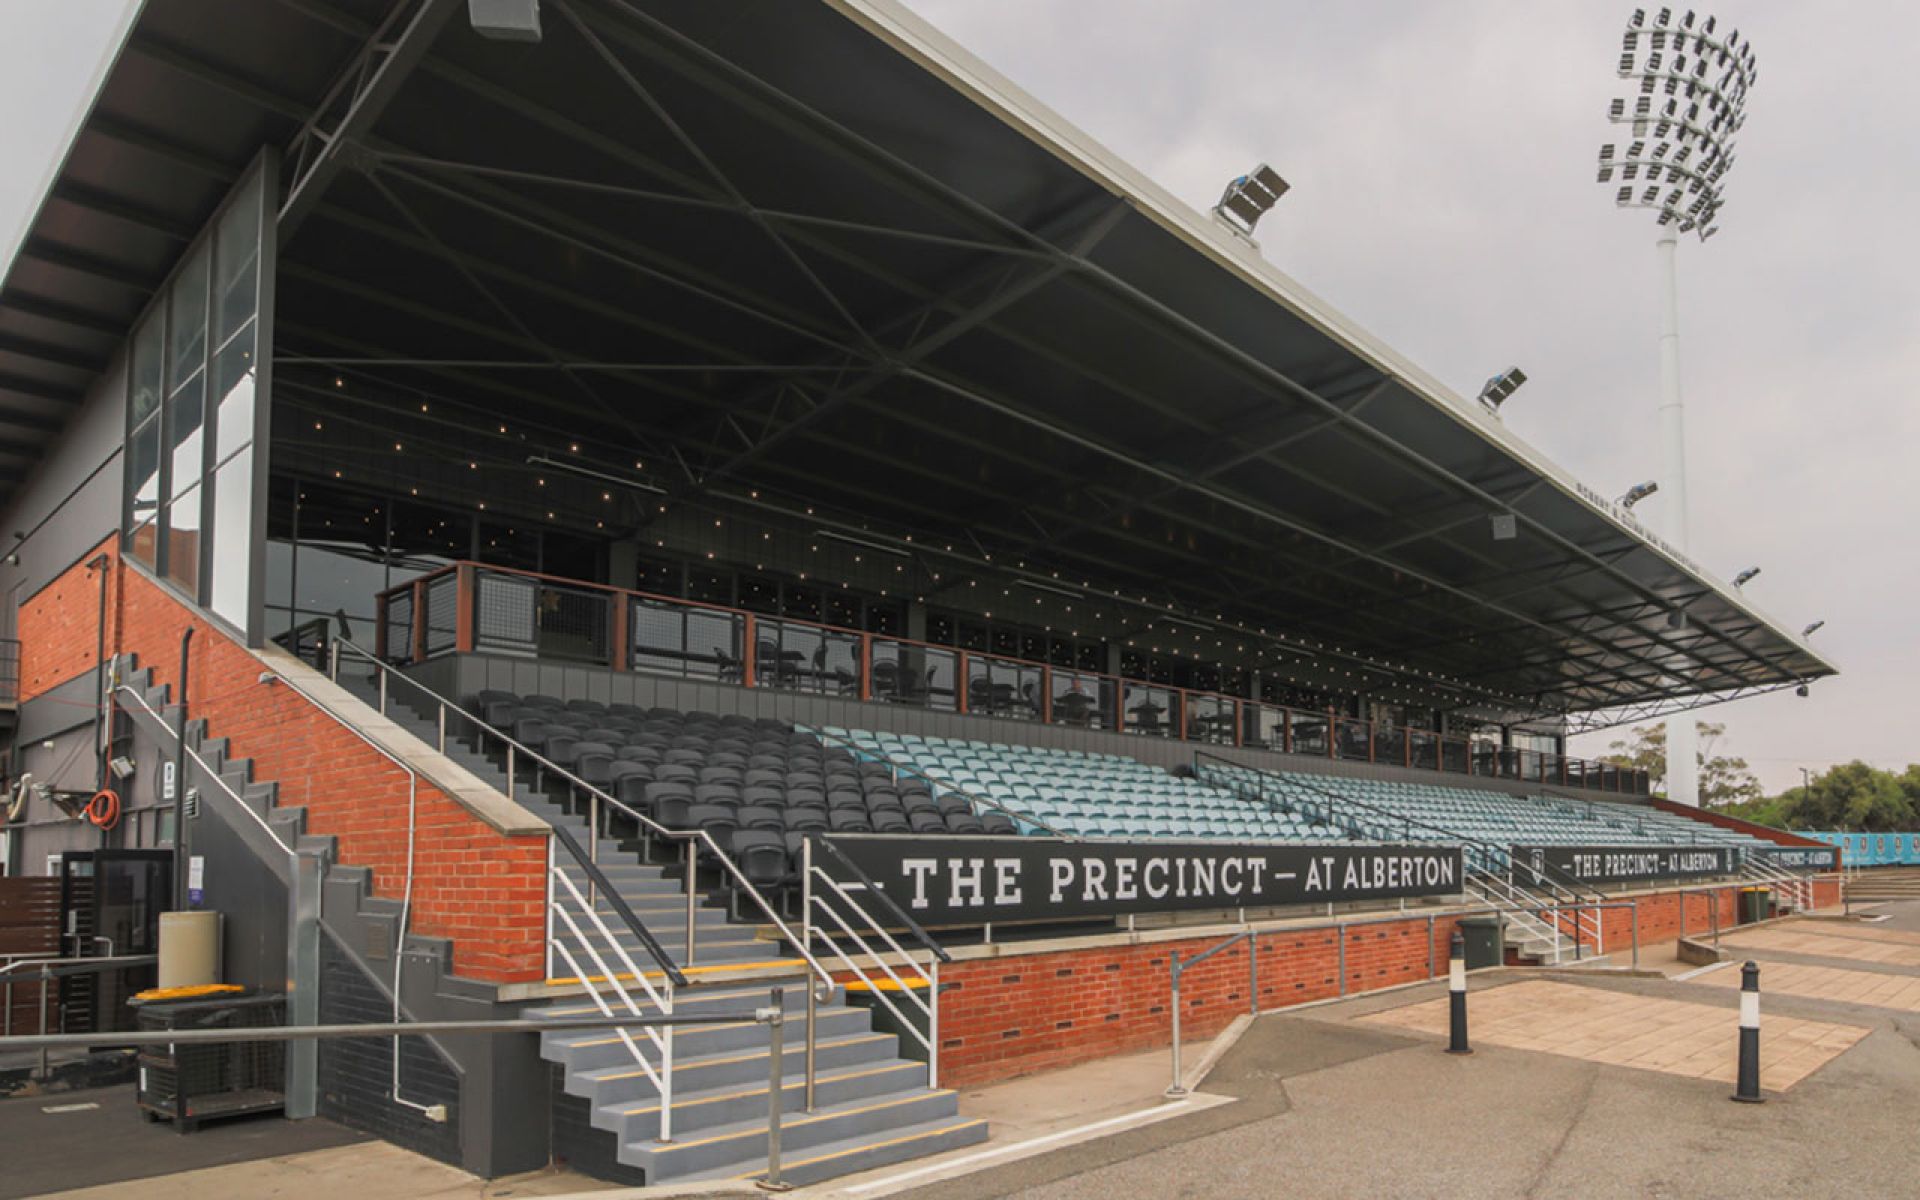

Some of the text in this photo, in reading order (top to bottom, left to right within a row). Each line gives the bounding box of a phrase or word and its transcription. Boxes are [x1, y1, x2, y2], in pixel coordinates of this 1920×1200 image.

[902, 856, 1453, 909] THE PRECINCT AT ALBERTON
[1573, 854, 1600, 877] THE
[1604, 853, 1660, 876] PRECINCT
